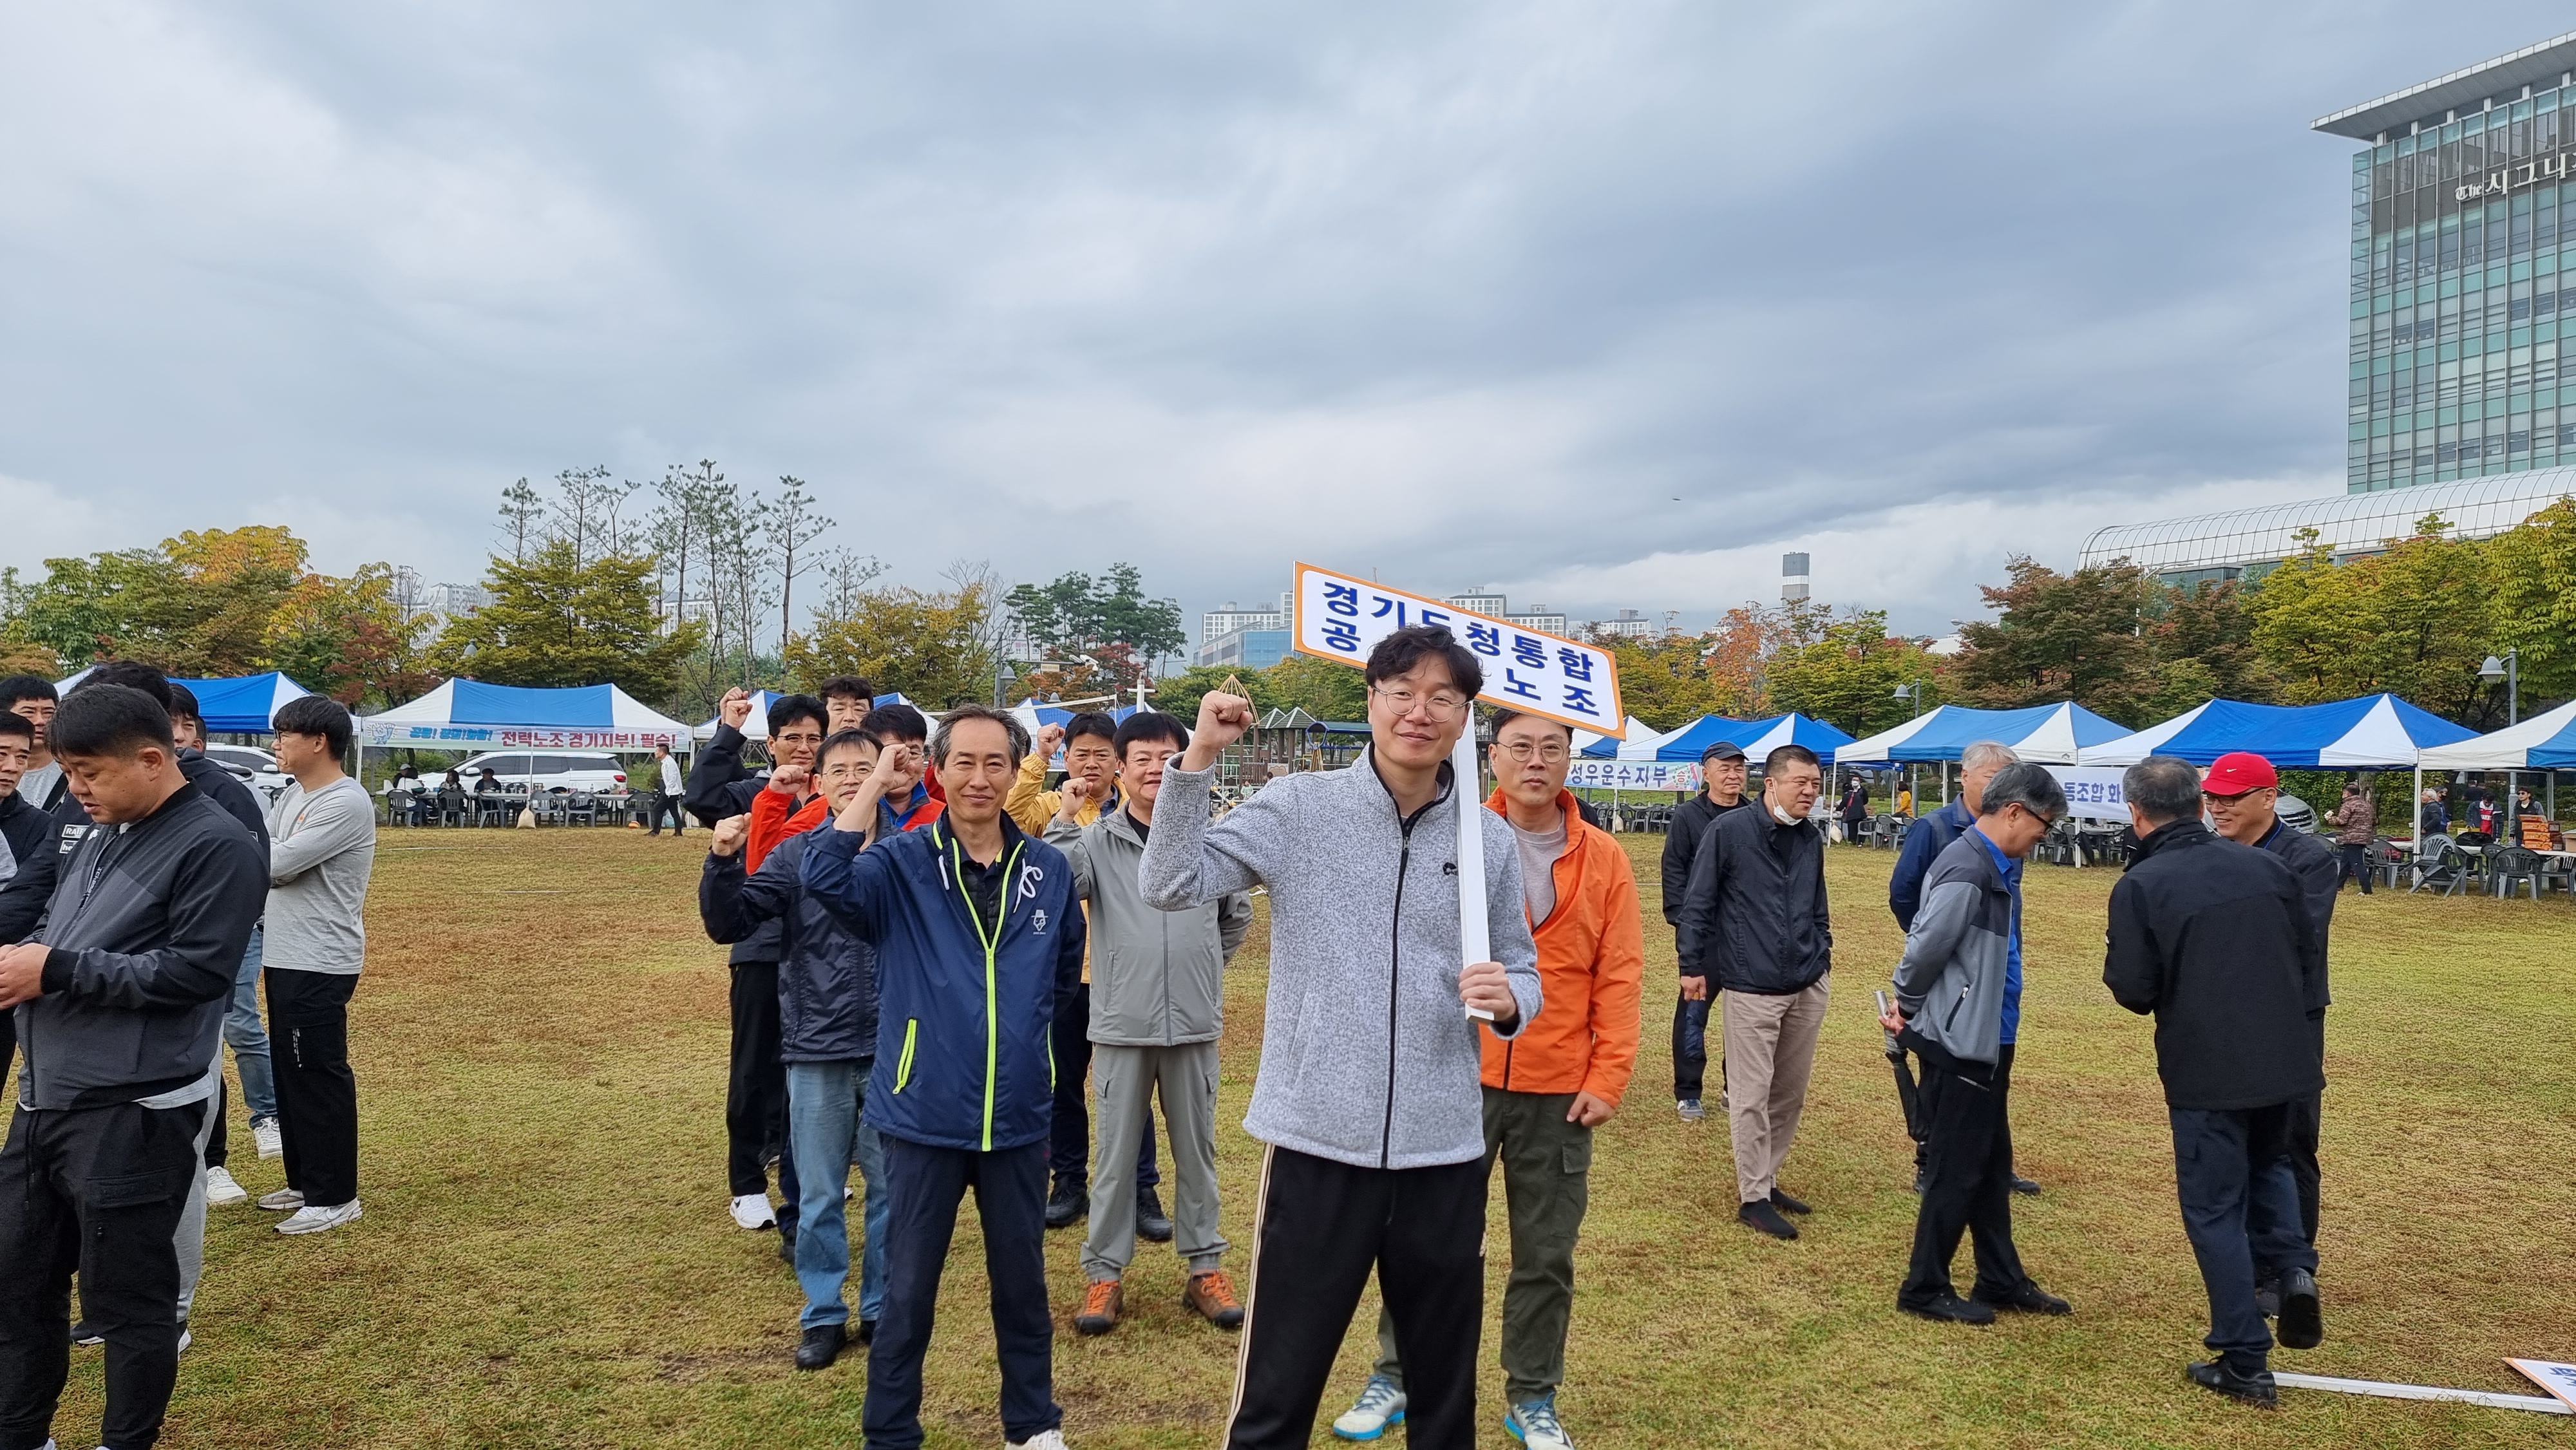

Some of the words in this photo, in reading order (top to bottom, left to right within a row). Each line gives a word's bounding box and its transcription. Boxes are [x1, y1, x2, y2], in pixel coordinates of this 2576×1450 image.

[2485, 153, 2576, 194] 시그니
[501, 731, 564, 748] 전력노조
[569, 733, 635, 748] 경기지부!
